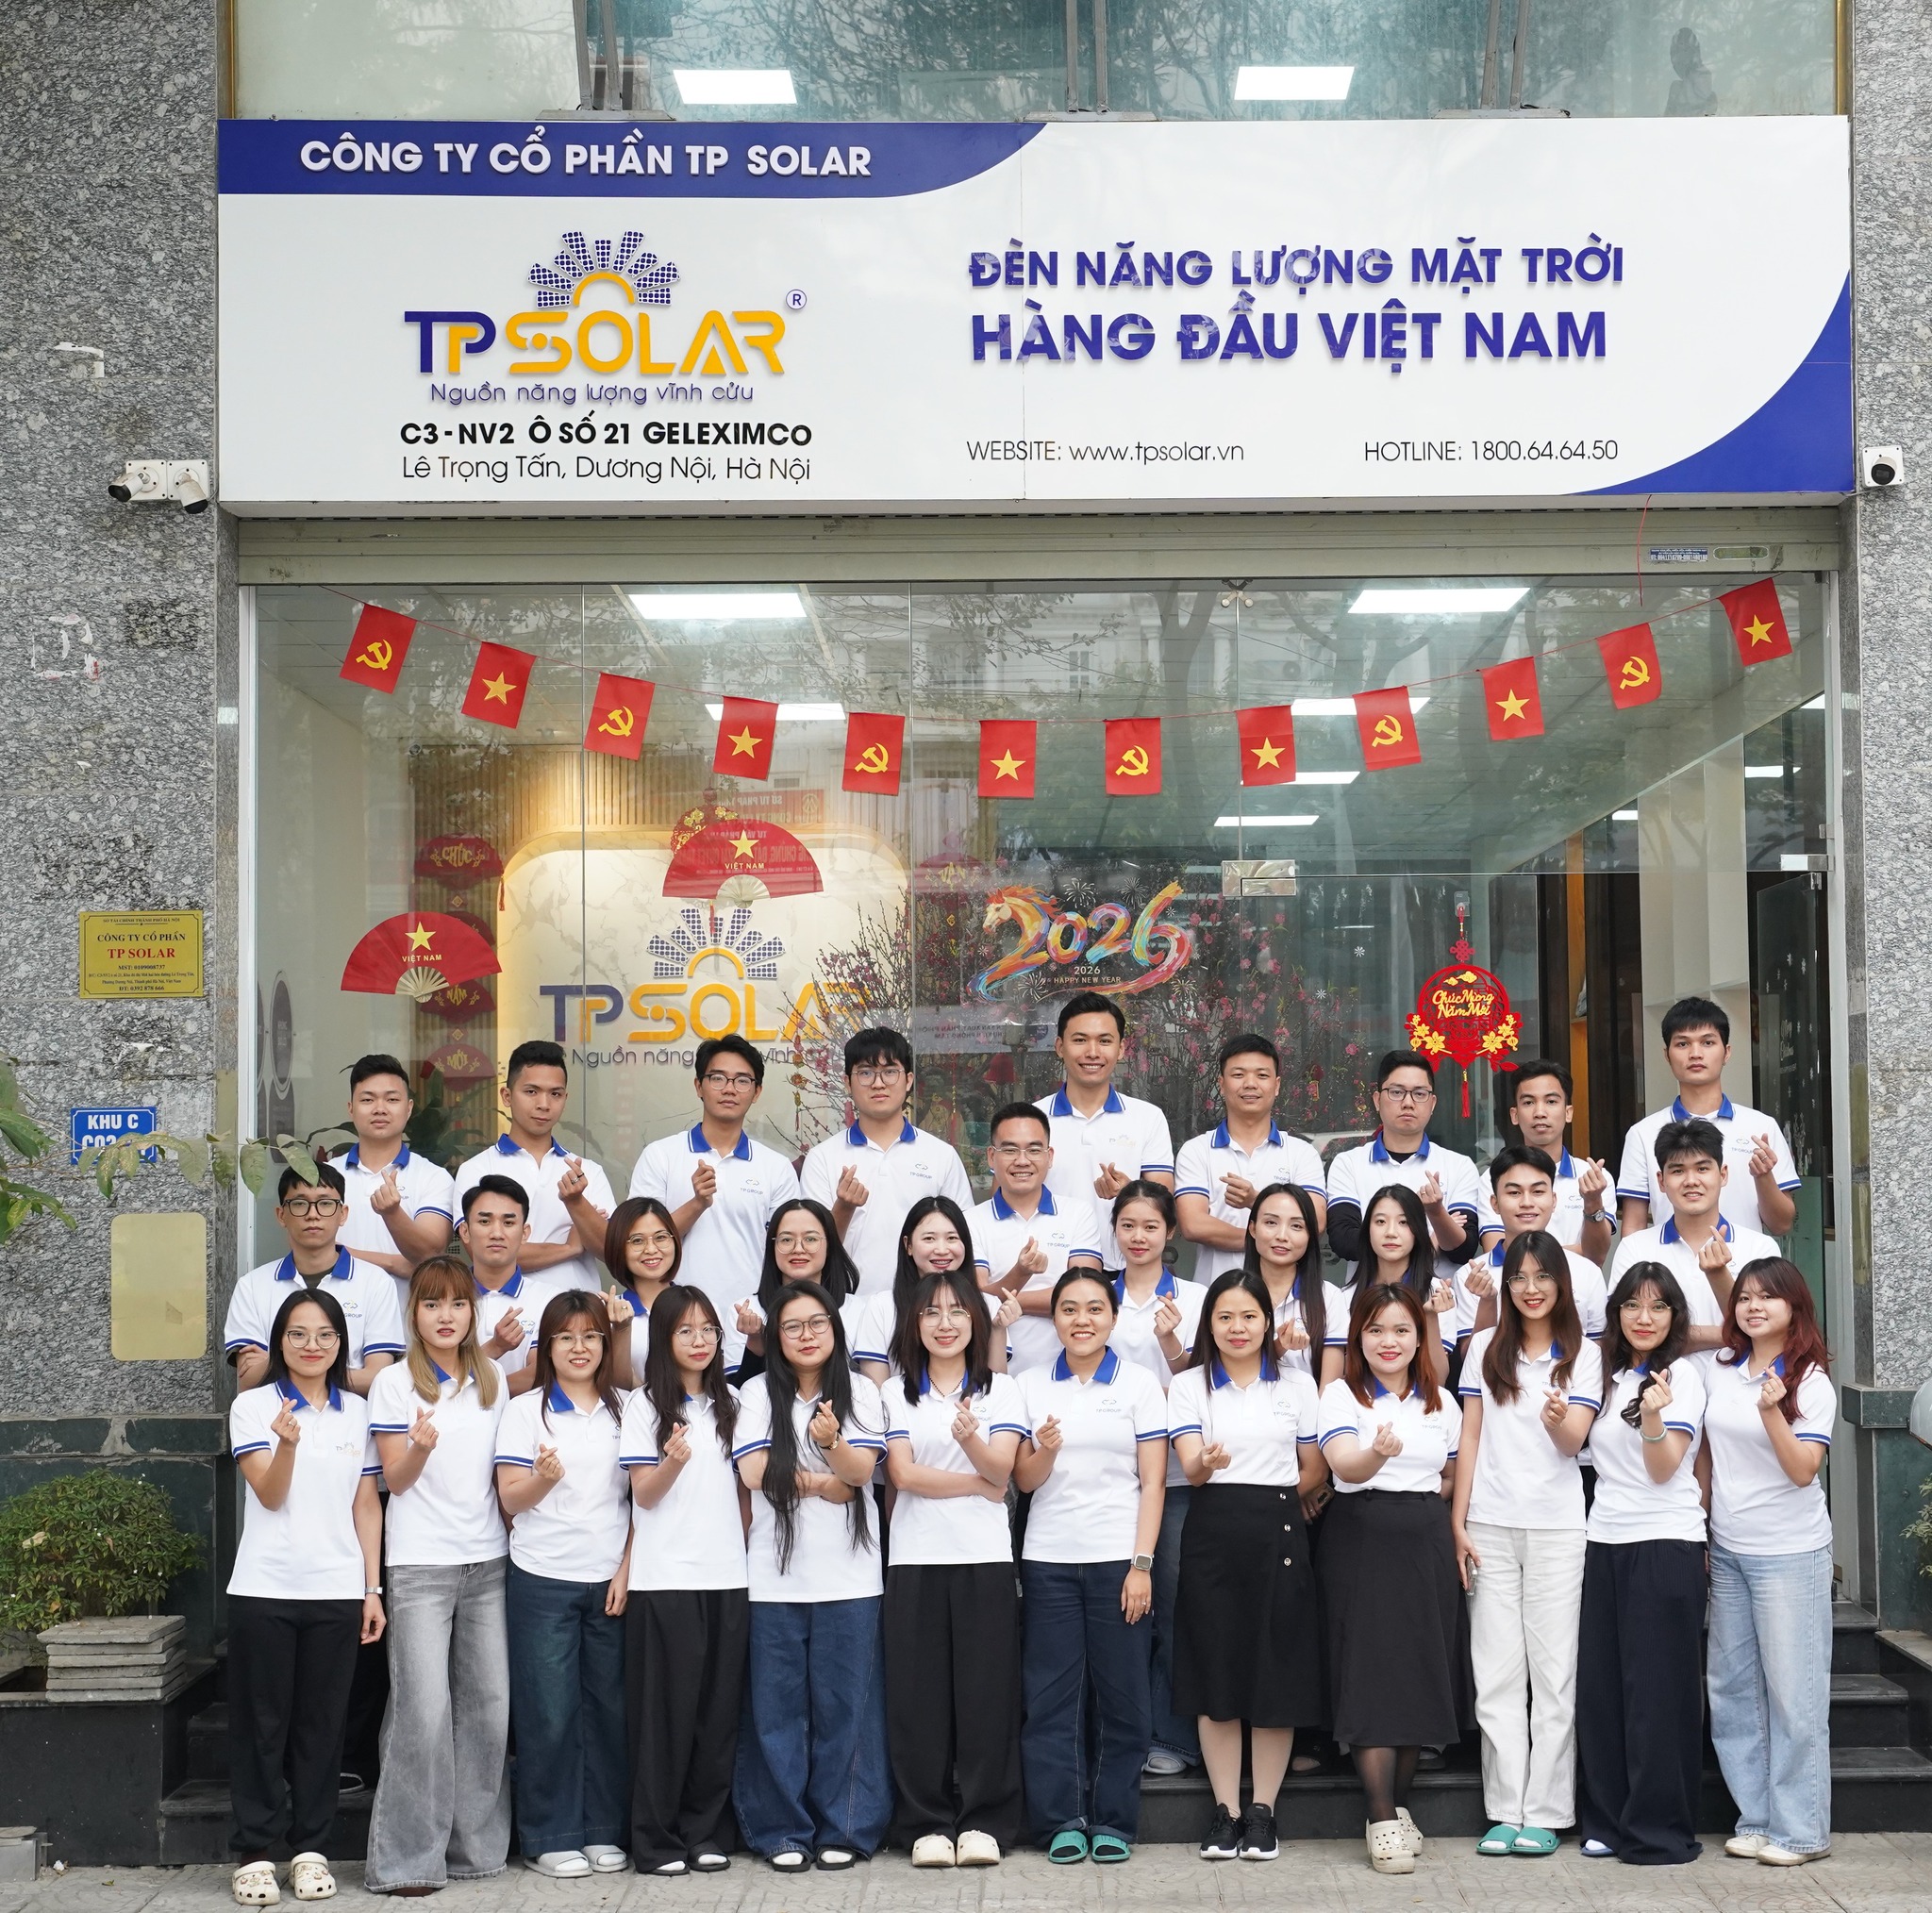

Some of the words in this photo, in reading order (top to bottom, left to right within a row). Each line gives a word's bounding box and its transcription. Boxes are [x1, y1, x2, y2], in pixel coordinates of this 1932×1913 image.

[300, 133, 422, 173] CÔNG
[435, 143, 478, 173] TY
[490, 125, 551, 175] CỔ
[565, 129, 673, 176] PHẦN
[686, 146, 728, 175] TP
[748, 145, 872, 177] SOLAR
[969, 238, 1058, 287] ĐÈN
[1076, 241, 1213, 287] NĂNG
[1232, 245, 1393, 298] LƯỢNG
[1411, 238, 1503, 294] MẶT
[1521, 233, 1624, 283] TRỜI
[972, 300, 1156, 361] HÀNG
[1176, 291, 1299, 360] ĐẦU
[1318, 298, 1442, 373] VIỆT
[1463, 309, 1607, 358] NAM
[431, 383, 508, 406] Nguồn
[518, 383, 576, 406] năng
[586, 383, 647, 406] lượng
[657, 382, 702, 401] vĩnh
[712, 381, 754, 401] cửu
[528, 415, 552, 444] Ô
[558, 410, 597, 444] SỐ
[603, 423, 629, 444] 21
[643, 422, 812, 446] GELEXIMCO
[967, 441, 1061, 462] WEBSITE:
[1069, 441, 1244, 466] www.tpsolar.vn
[1365, 441, 1463, 461] HOTLINE:
[1473, 440, 1618, 461] 1800.64.64.50
[403, 456, 431, 477] Lê
[439, 457, 508, 484] Trọng
[516, 453, 567, 480] Tấn,
[576, 457, 662, 484] Dương
[671, 456, 717, 484] Nội,
[727, 457, 761, 479] Hà
[771, 457, 810, 485] Nội
[97, 933, 125, 942] CÔNG
[108, 948, 125, 958] TP
[128, 948, 175, 958] SOLAR
[402, 955, 422, 963] VIỆT
[1074, 966, 1101, 975] 2026
[1432, 990, 1461, 1005] Chúc
[572, 1046, 637, 1068] Nguồn
[643, 1048, 694, 1068] năng
[88, 1114, 123, 1130] KHU
[127, 1114, 139, 1129] C
